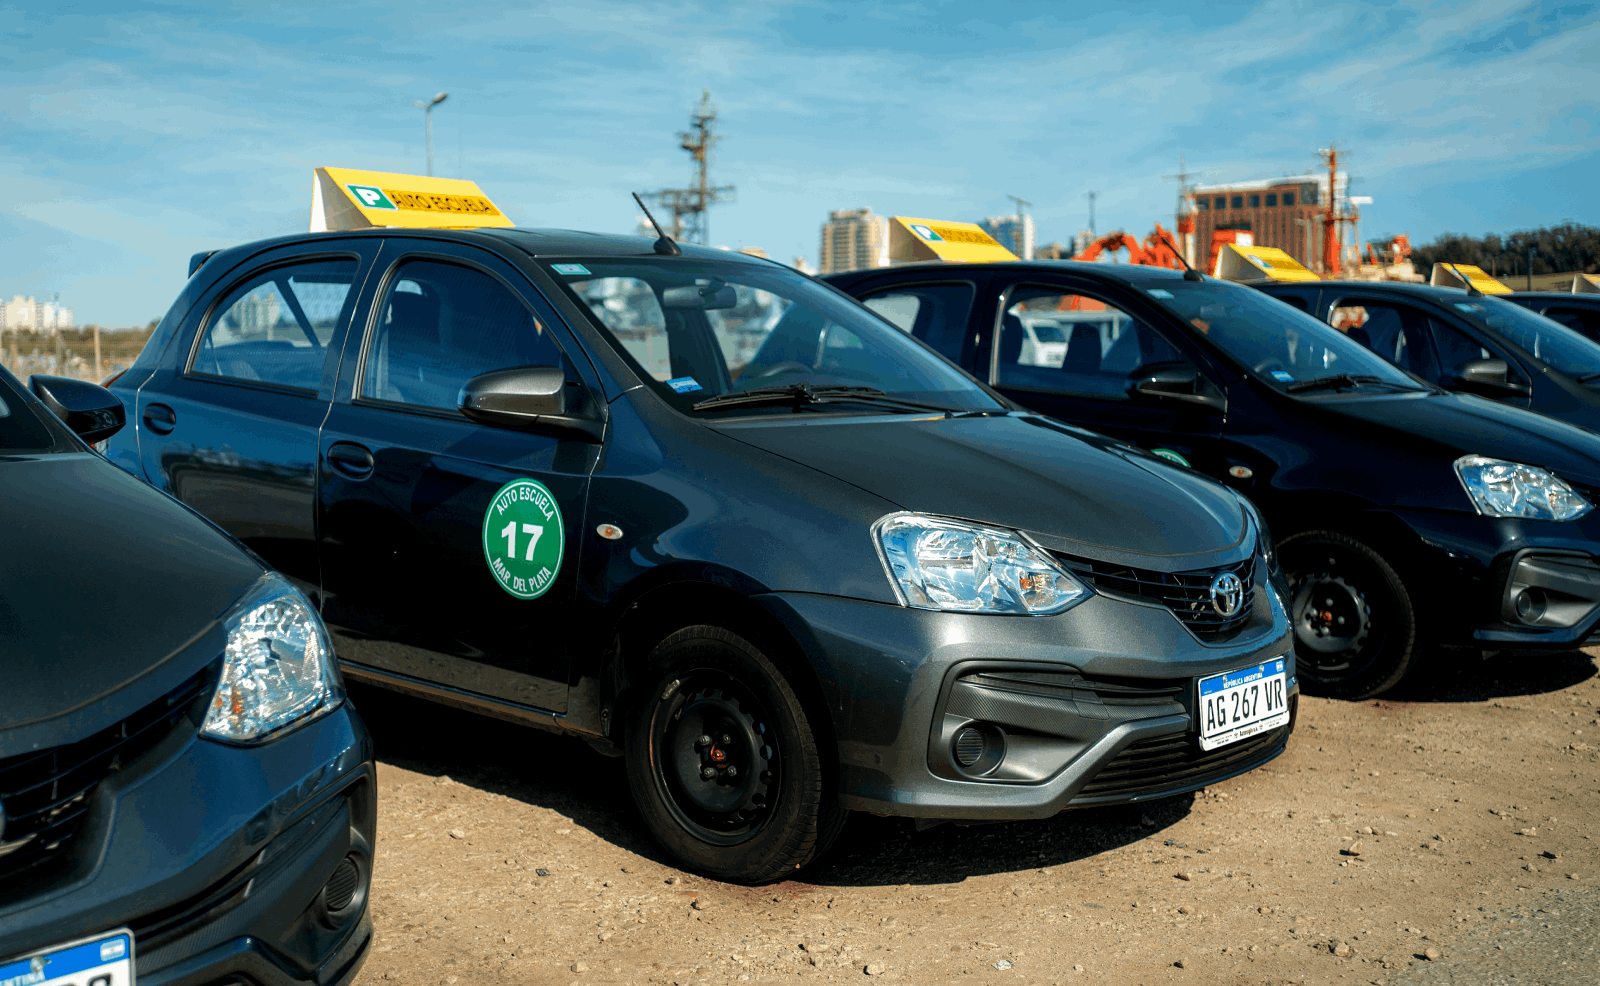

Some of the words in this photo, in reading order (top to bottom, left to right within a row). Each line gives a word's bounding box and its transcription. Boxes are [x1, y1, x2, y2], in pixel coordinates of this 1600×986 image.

[355, 188, 380, 205] P
[390, 192, 431, 208] AUTO
[430, 196, 492, 211] ESCUELA
[496, 489, 517, 516] AUTO
[520, 487, 554, 522] ESCUELA
[501, 521, 544, 561] 17
[493, 557, 511, 584] MAR
[513, 576, 528, 592] DEL
[528, 567, 552, 592] PLATA
[1207, 695, 1226, 731] AG
[1231, 685, 1258, 723] 267
[1264, 679, 1283, 711] VR
